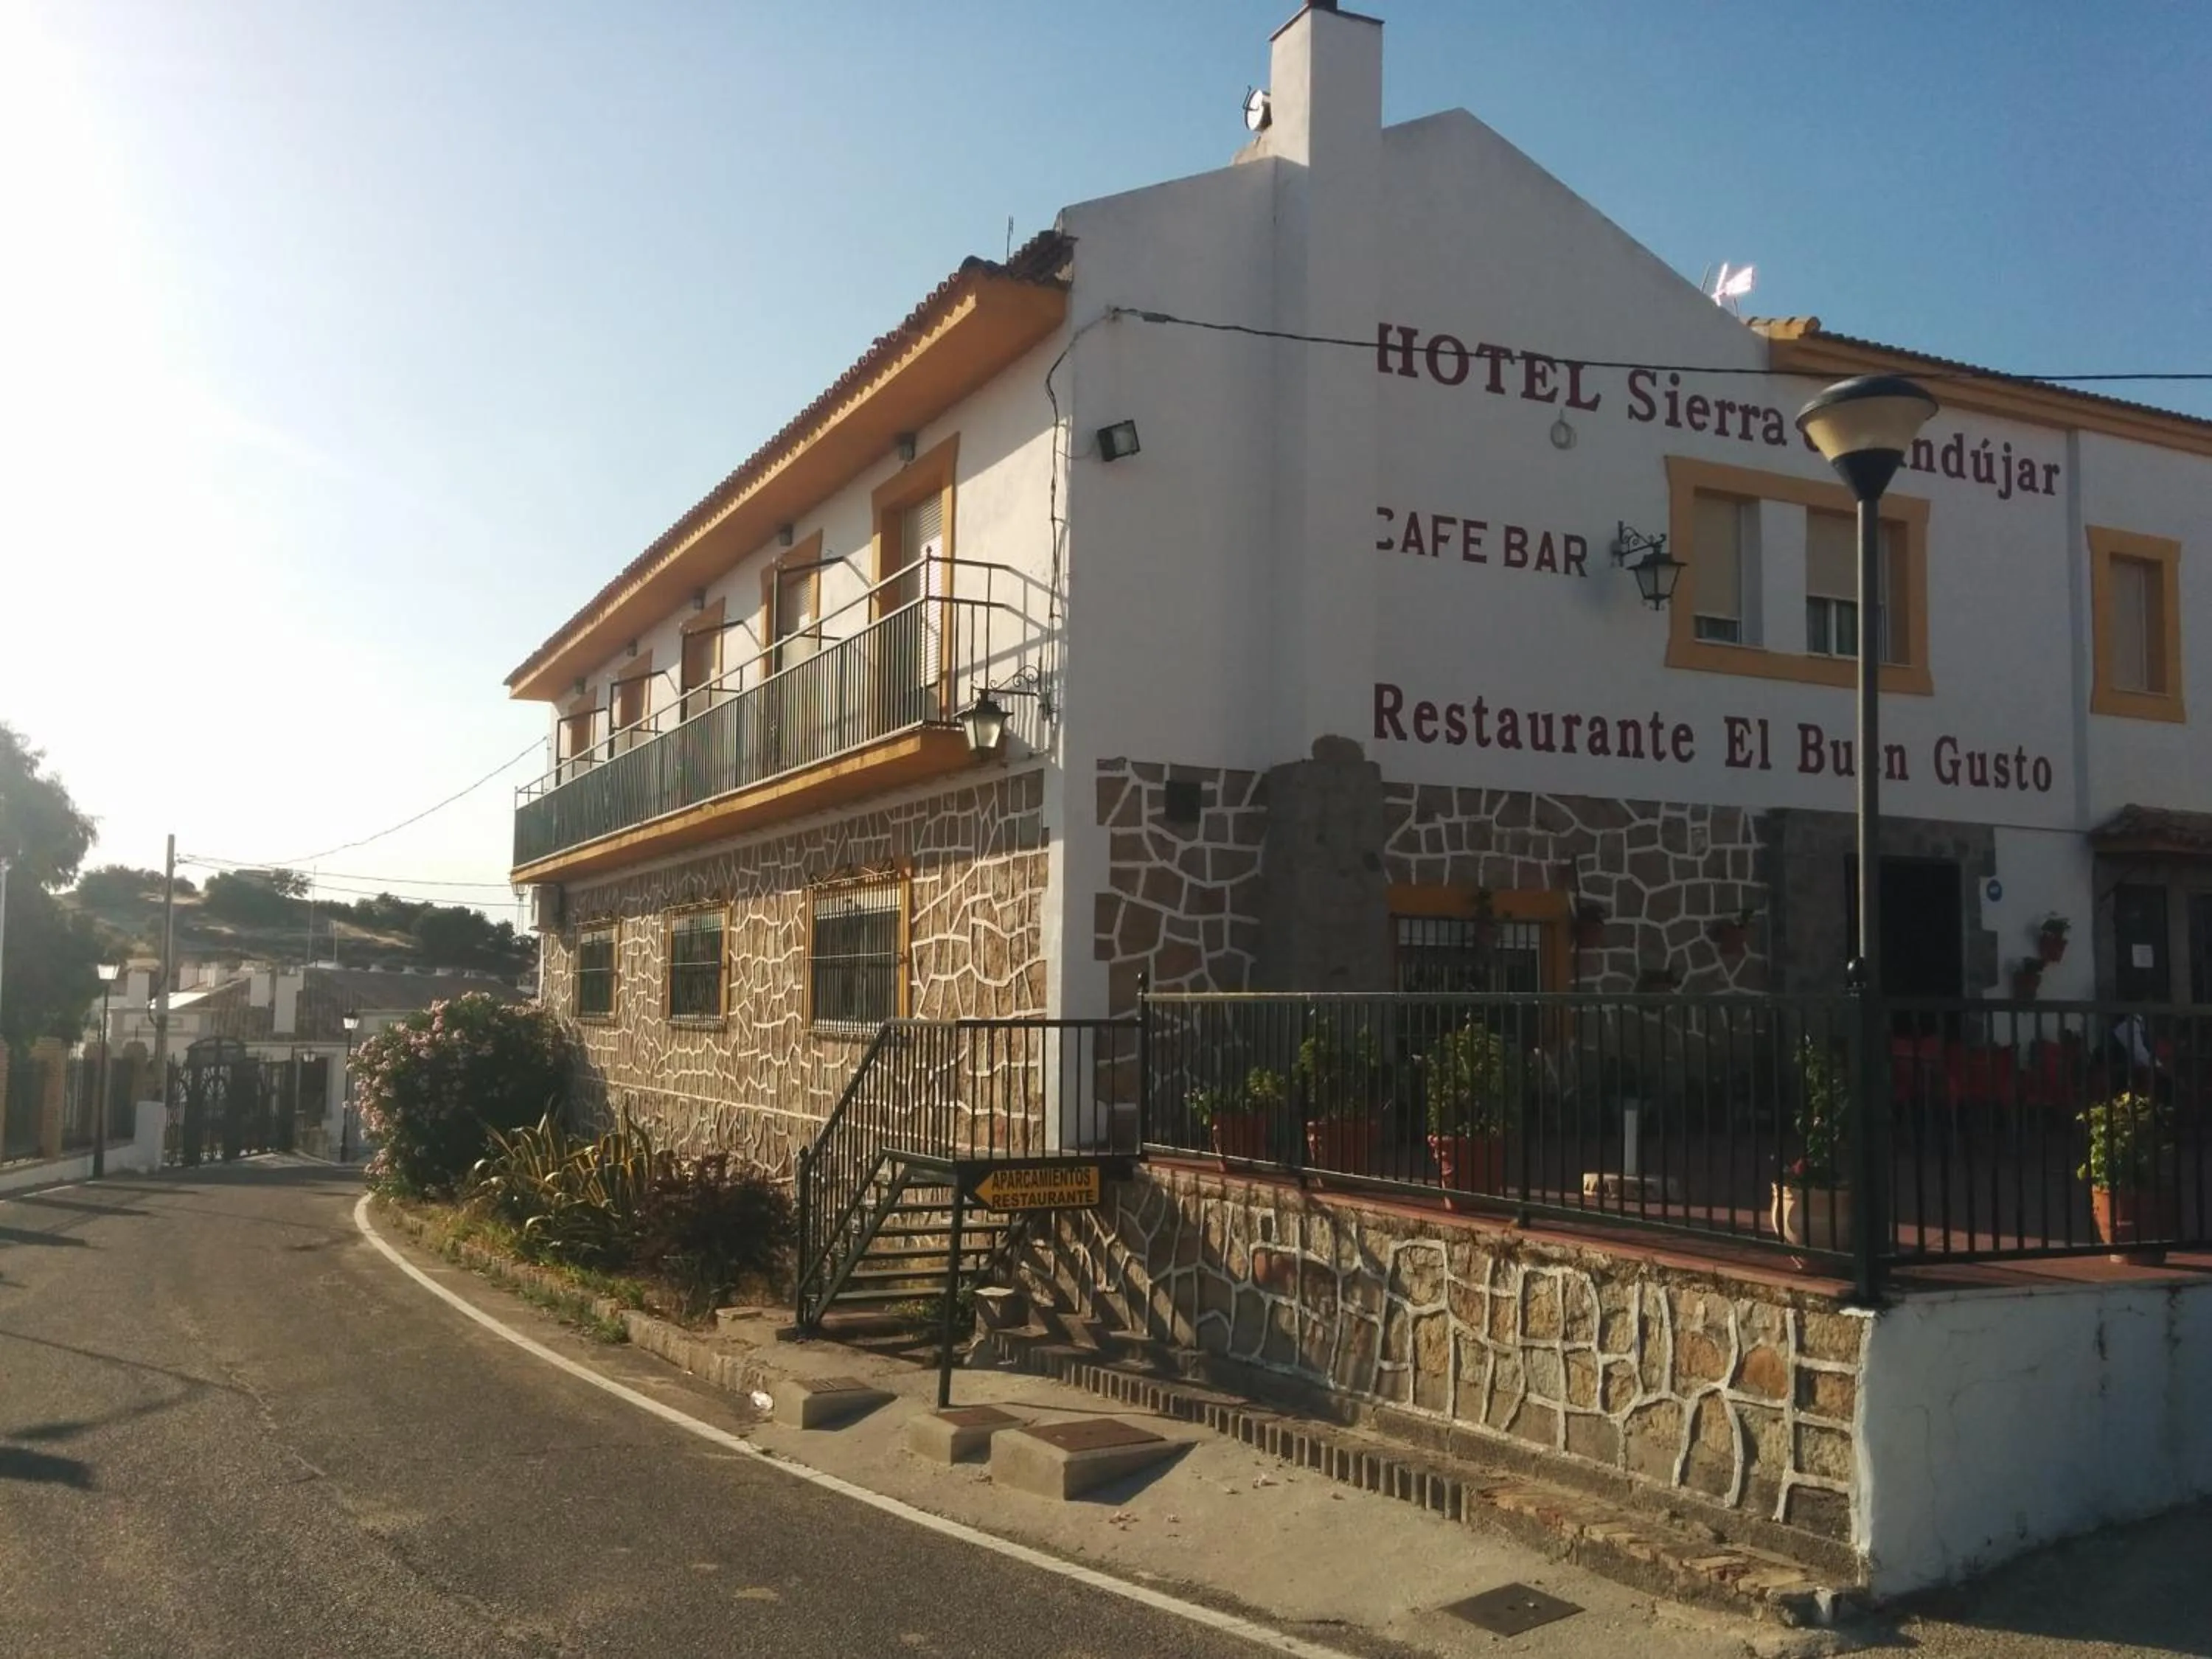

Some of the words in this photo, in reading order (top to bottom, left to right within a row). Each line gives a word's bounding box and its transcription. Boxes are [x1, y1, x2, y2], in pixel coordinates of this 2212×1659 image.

[1377, 322, 1601, 411] HOTEL
[1627, 369, 1788, 447] Sierra
[1900, 432, 2061, 499] ndújar
[1503, 524, 1588, 577] BAR
[1374, 683, 1695, 763] Restaurante
[1724, 715, 1772, 770] El
[1798, 723, 1909, 781] Bun
[1934, 735, 2052, 792] Gusto
[991, 1167, 1091, 1192] APARCAMIENTOS
[991, 1189, 1093, 1208] RESTAURANTE
